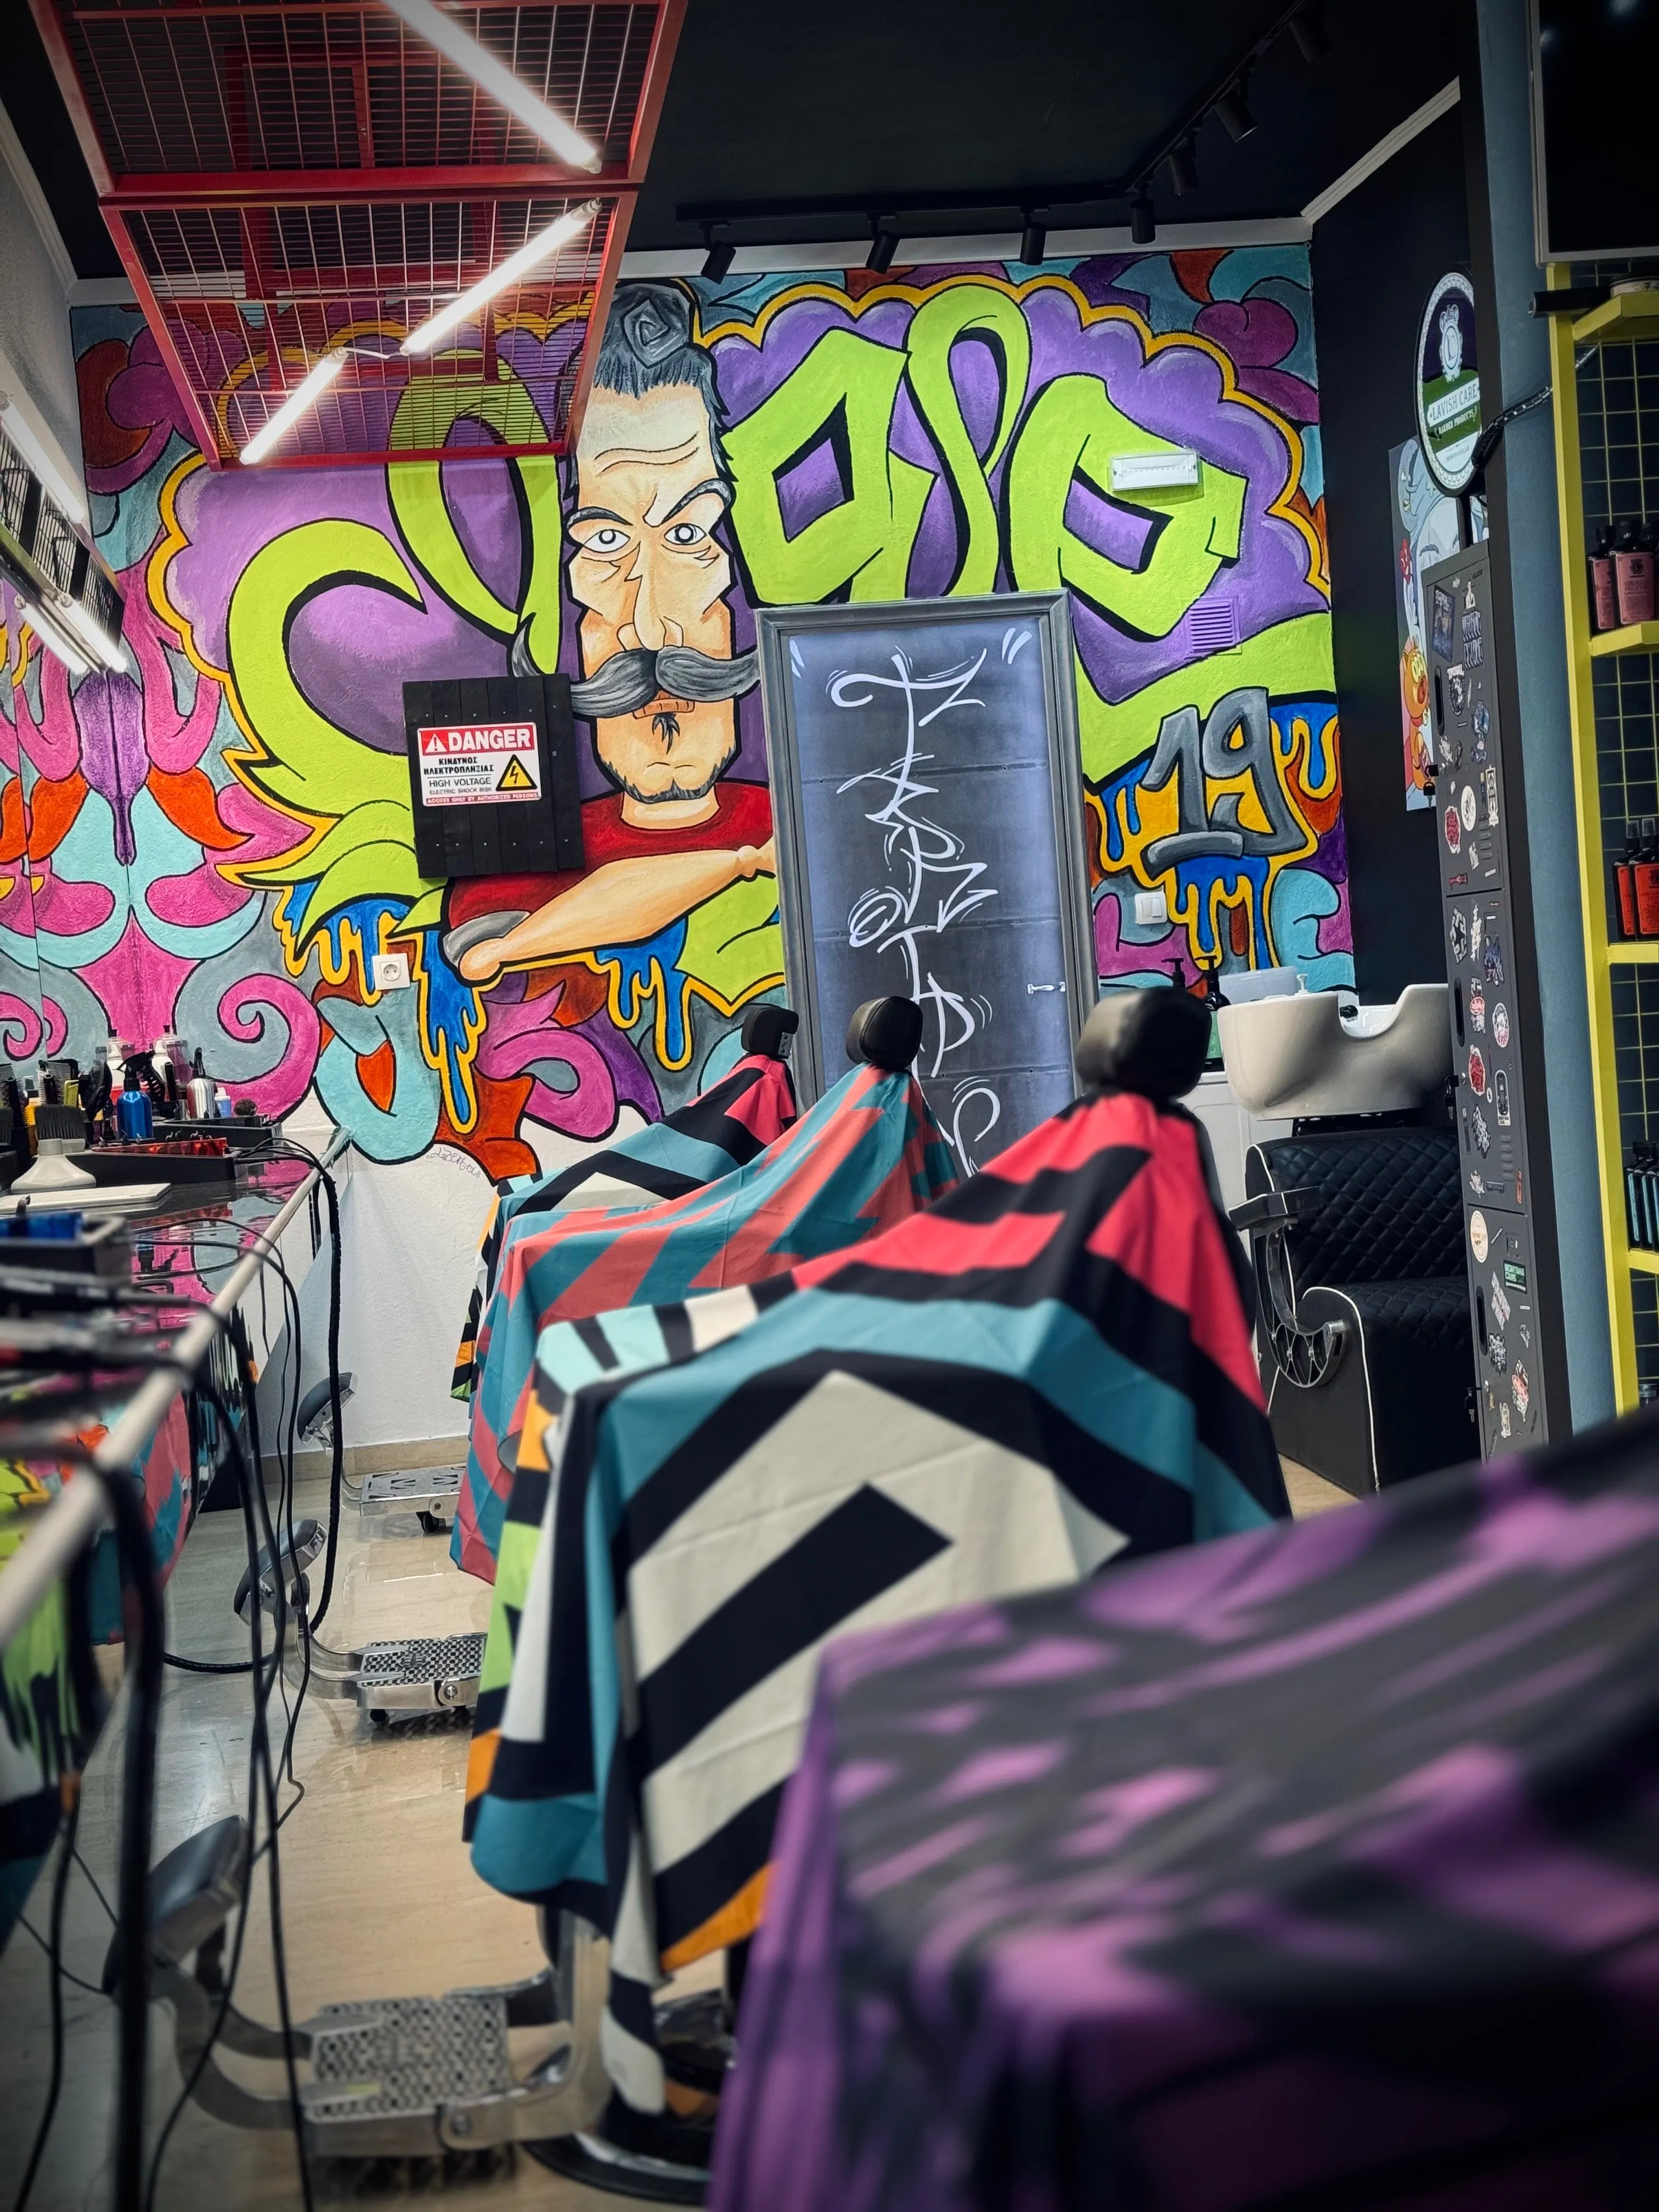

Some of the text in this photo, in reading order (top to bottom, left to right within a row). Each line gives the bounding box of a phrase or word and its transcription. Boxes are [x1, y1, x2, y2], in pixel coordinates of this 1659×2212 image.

[1432, 383, 1477, 421] LAVISH CARE
[448, 728, 532, 752] DANGER
[439, 757, 478, 765] ΚΙΝΔΥΝΟΣ
[424, 765, 494, 775] ΗΛΕΚΤΡΟΠΛΗΞΙΑΣ
[429, 777, 492, 787] HIGH VOLTAGE
[1141, 686, 1308, 878] 19
